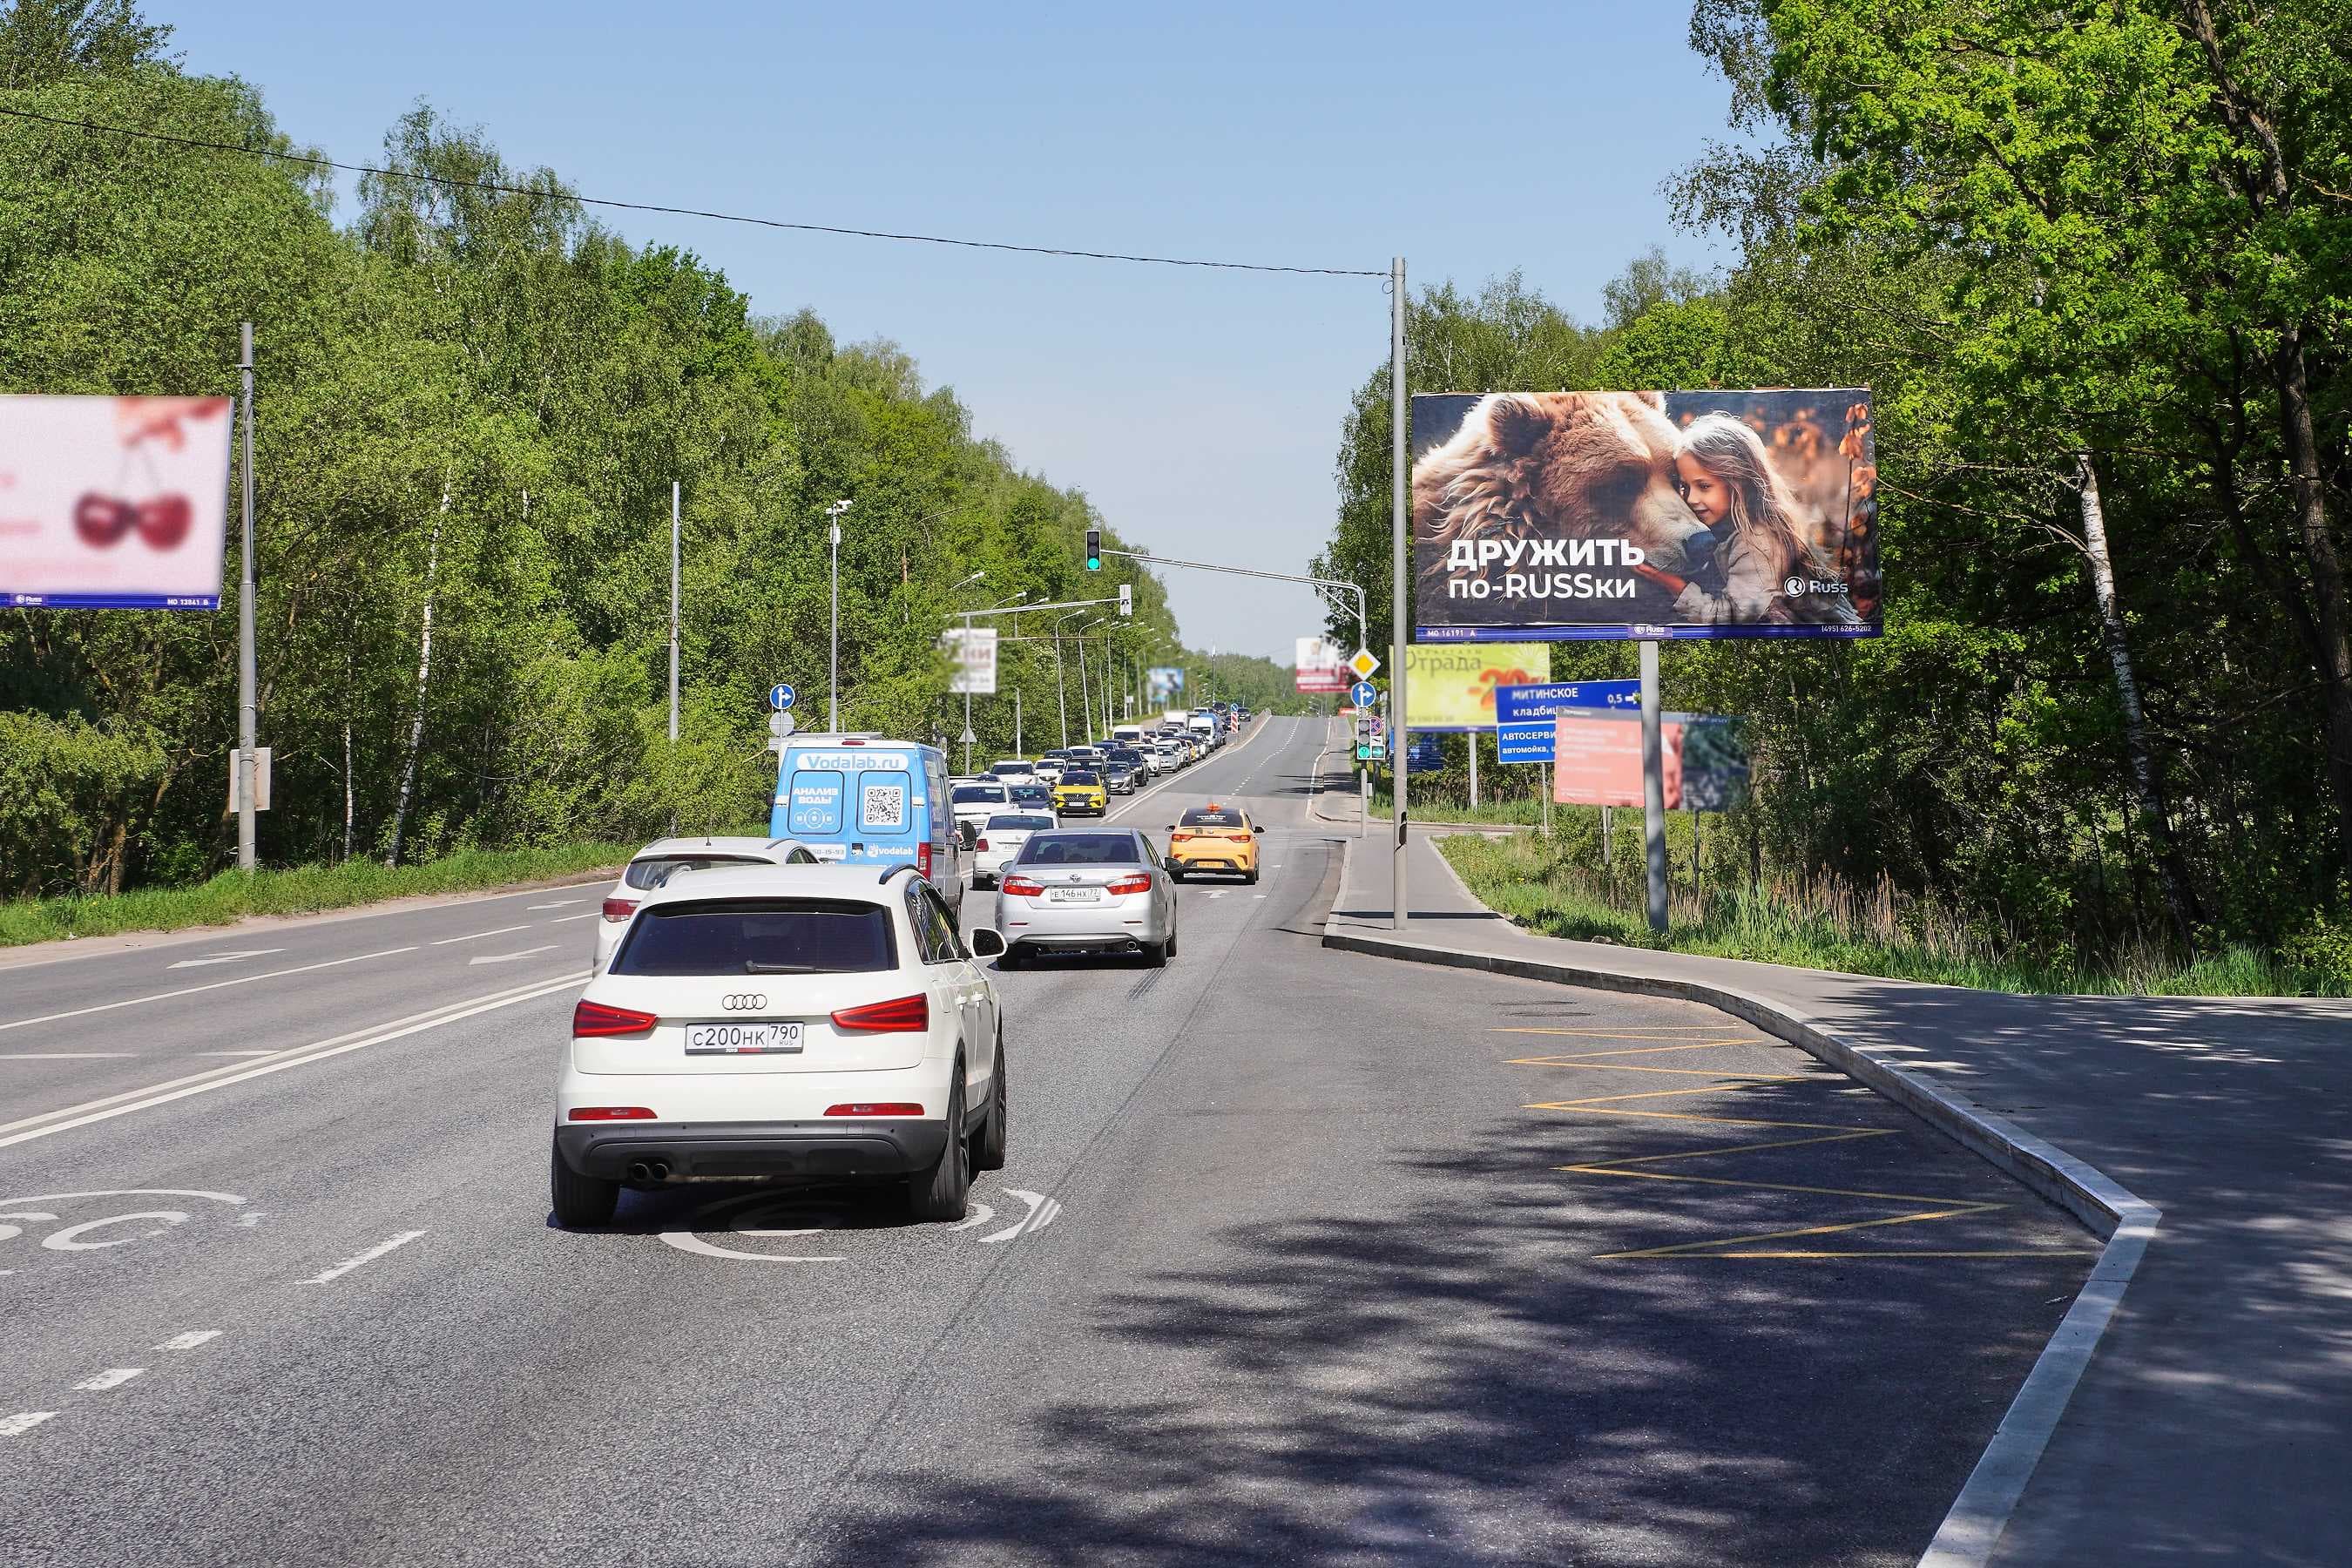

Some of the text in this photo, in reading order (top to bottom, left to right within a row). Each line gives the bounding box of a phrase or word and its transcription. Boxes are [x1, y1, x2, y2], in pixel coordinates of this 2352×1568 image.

[1447, 539, 1646, 571] ДРУЖИТЬ
[1449, 573, 1636, 598] по-RUSSки
[1809, 580, 1848, 593] Russ
[1442, 629, 1463, 638] 16191
[1511, 687, 1578, 700] МИТИНСКОЕ
[1607, 693, 1623, 704] 0,5
[807, 755, 899, 769] Vodalab.ru
[798, 795, 832, 804] ВОДЫ
[878, 847, 914, 855] vodalab
[770, 1025, 798, 1040] 790
